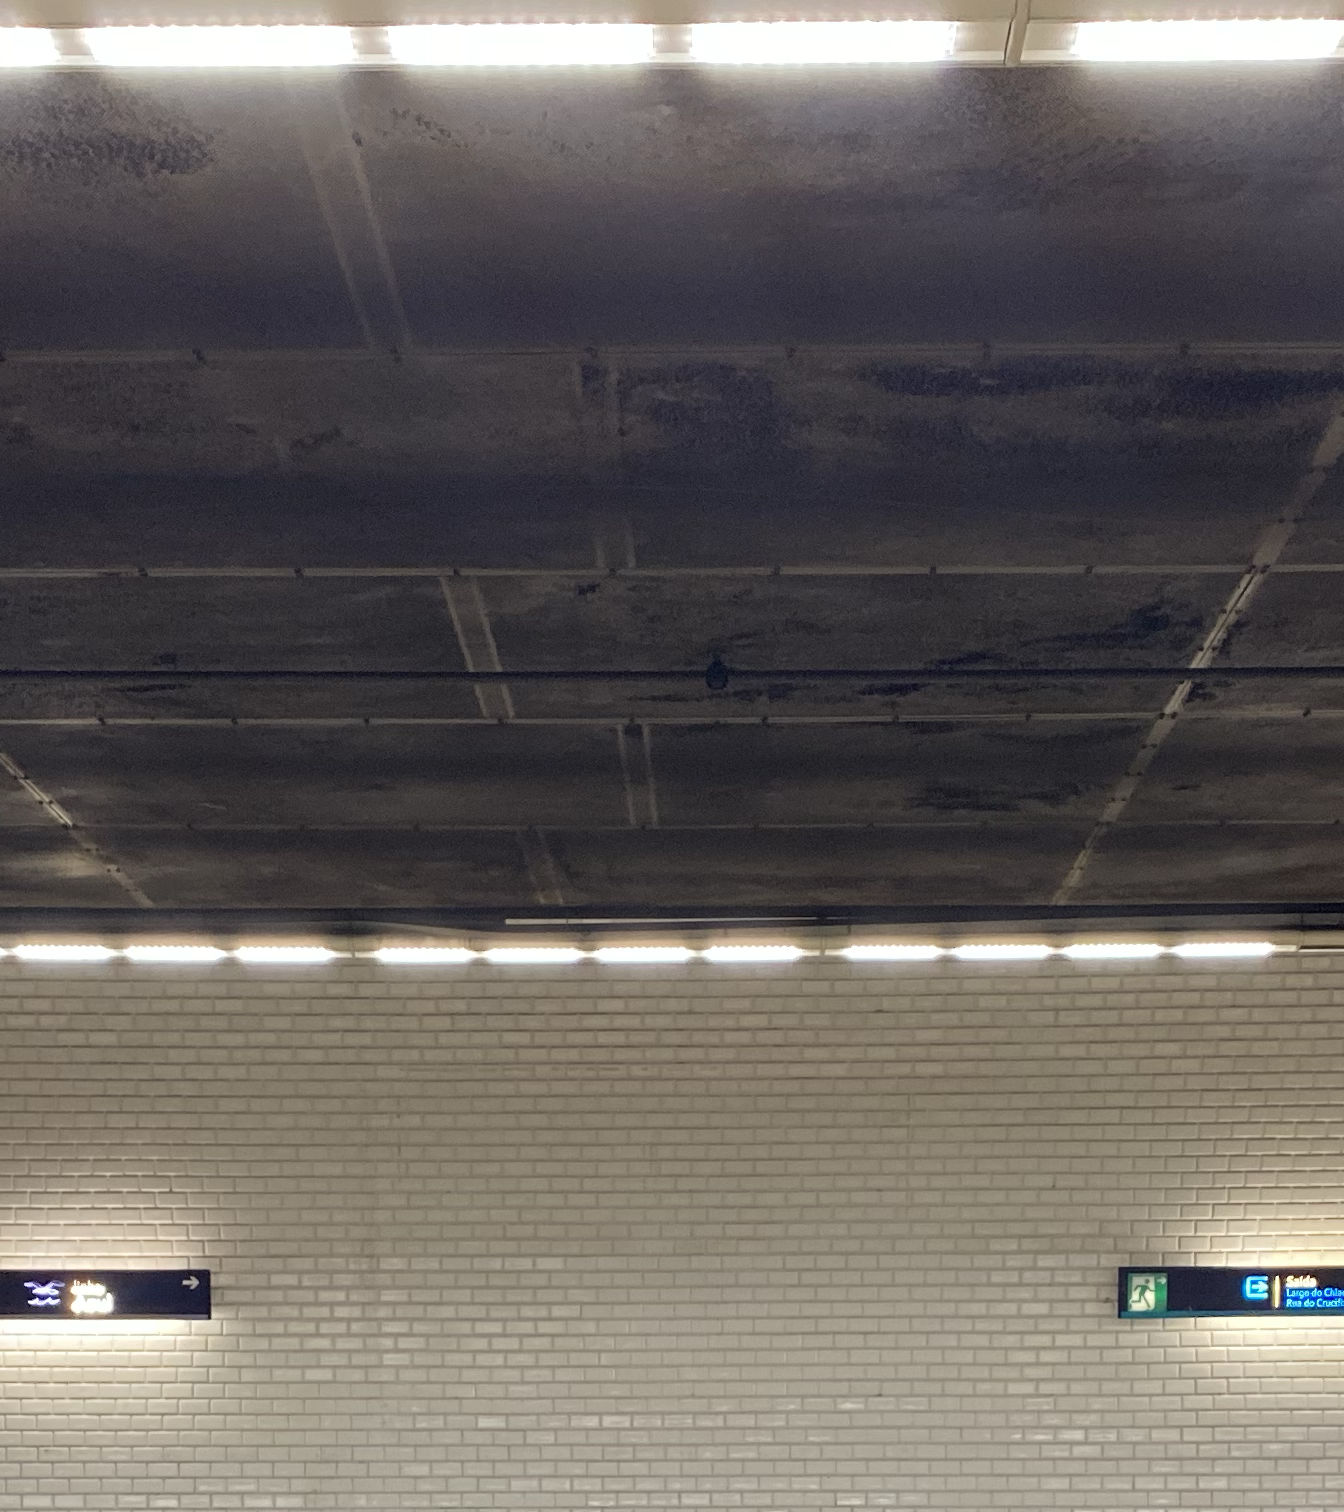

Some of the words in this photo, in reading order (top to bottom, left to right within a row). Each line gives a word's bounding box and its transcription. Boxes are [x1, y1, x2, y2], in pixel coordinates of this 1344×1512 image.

[1286, 1288, 1309, 1299] Largo
[1311, 1288, 1322, 1297] do
[1286, 1299, 1302, 1308] Rua
[1304, 1298, 1315, 1308] do
